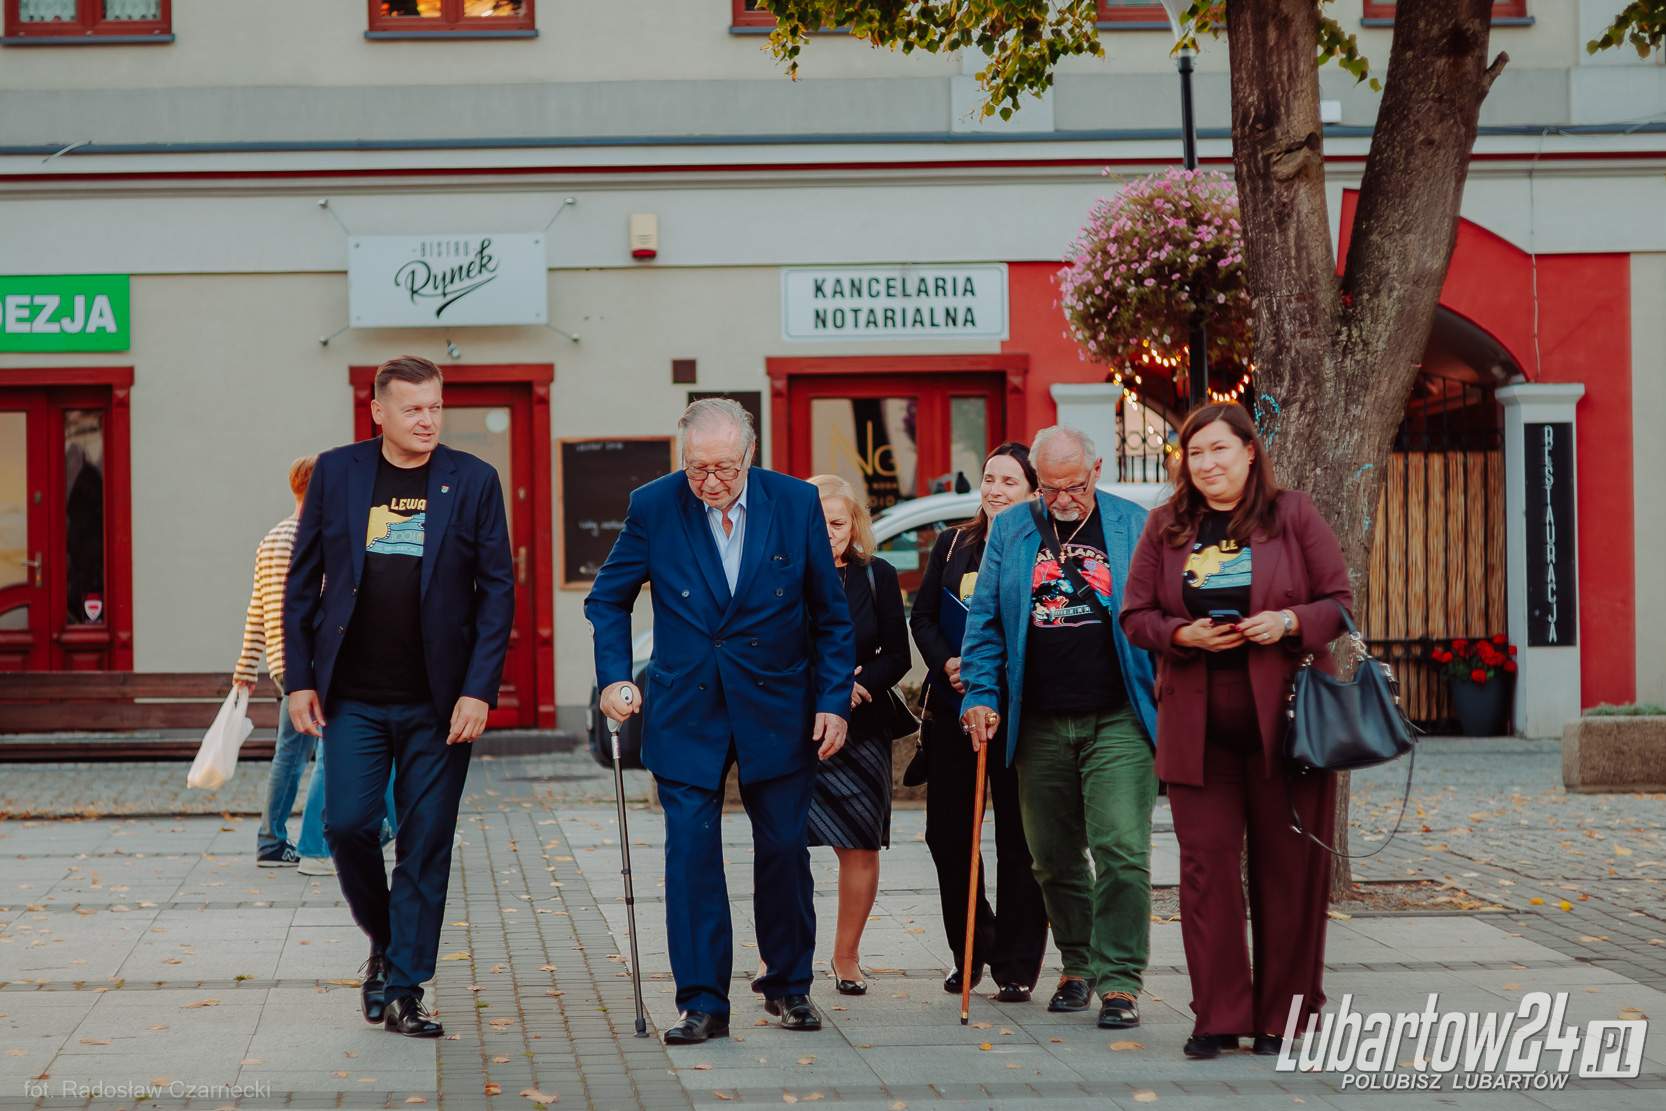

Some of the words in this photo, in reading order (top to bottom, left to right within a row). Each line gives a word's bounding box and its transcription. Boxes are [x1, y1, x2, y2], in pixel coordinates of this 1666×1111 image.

[394, 238, 498, 318] Rynek
[813, 276, 977, 299] KANCELARIA
[0, 294, 118, 334] EZJA
[814, 307, 977, 329] NOTARIALNA
[1544, 425, 1557, 643] RESTAURACJA
